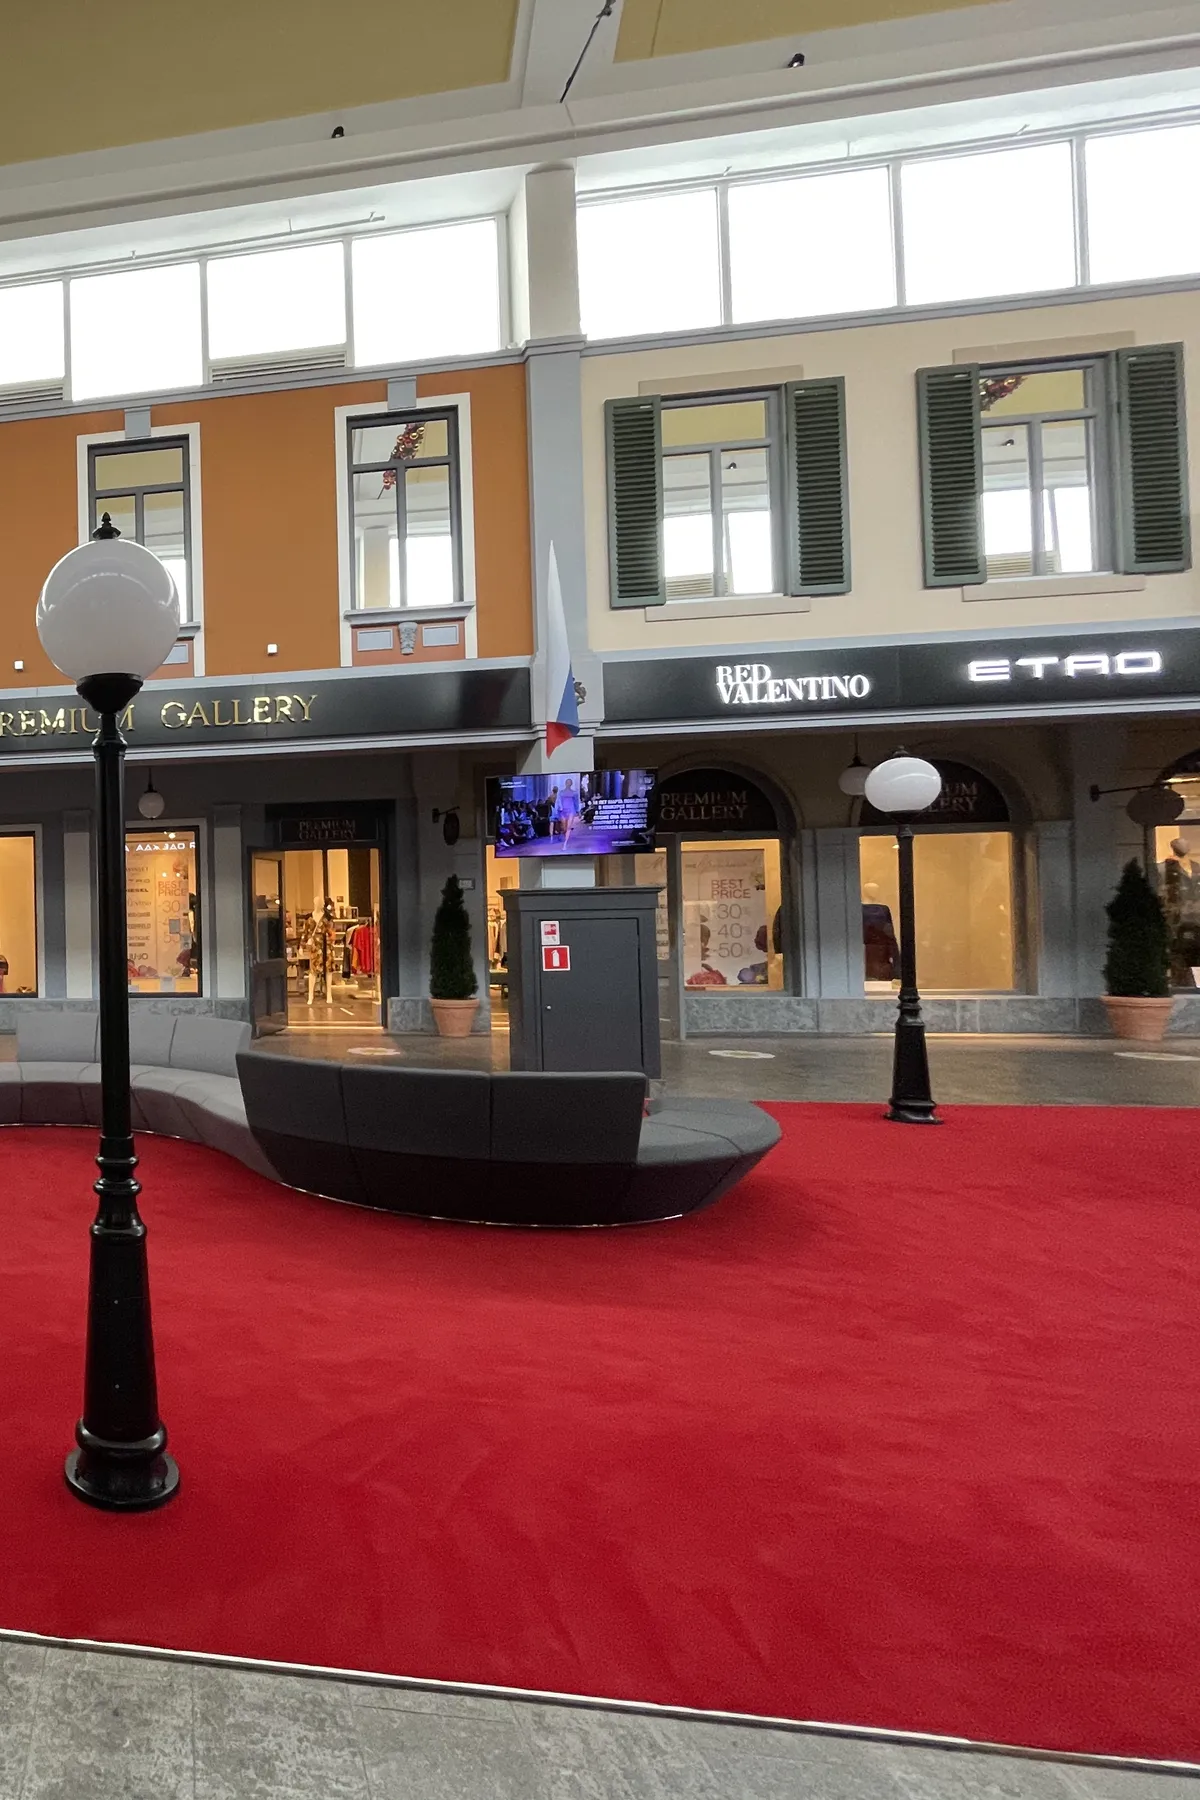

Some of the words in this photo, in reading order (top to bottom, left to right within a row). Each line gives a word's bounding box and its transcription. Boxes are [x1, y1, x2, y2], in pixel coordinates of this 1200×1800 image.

[716, 664, 771, 684] RED
[968, 652, 1161, 682] ETRO
[716, 674, 870, 704] VALENTINO
[161, 694, 318, 729] GALLERY
[660, 791, 747, 806] PREMIUM
[660, 805, 747, 821] GALLERY
[711, 878, 744, 889] BEST
[711, 888, 751, 899] PRICE
